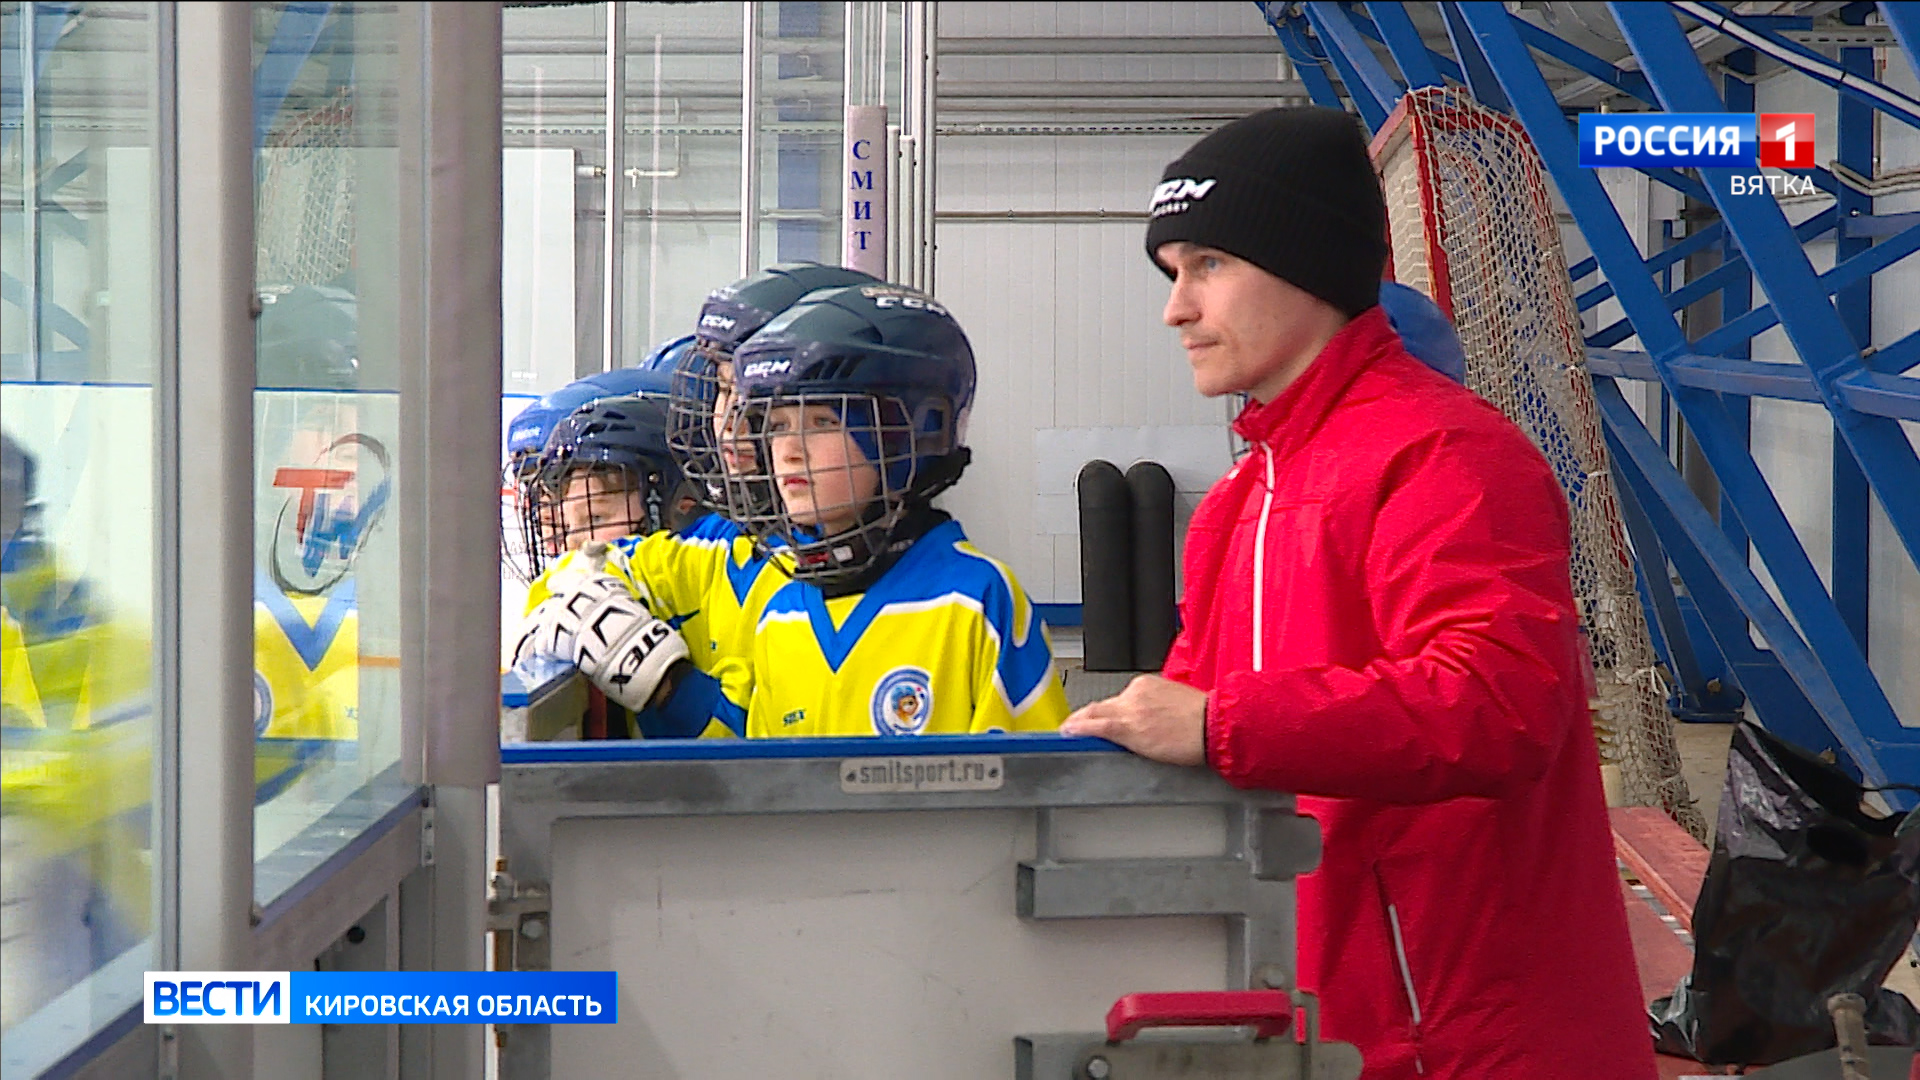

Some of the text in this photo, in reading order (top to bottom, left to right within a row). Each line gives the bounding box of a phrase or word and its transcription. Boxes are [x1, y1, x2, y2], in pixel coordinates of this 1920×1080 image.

[851, 139, 873, 250] СМИТ
[609, 622, 670, 695] STEX
[860, 759, 985, 789] smitsport.ru
